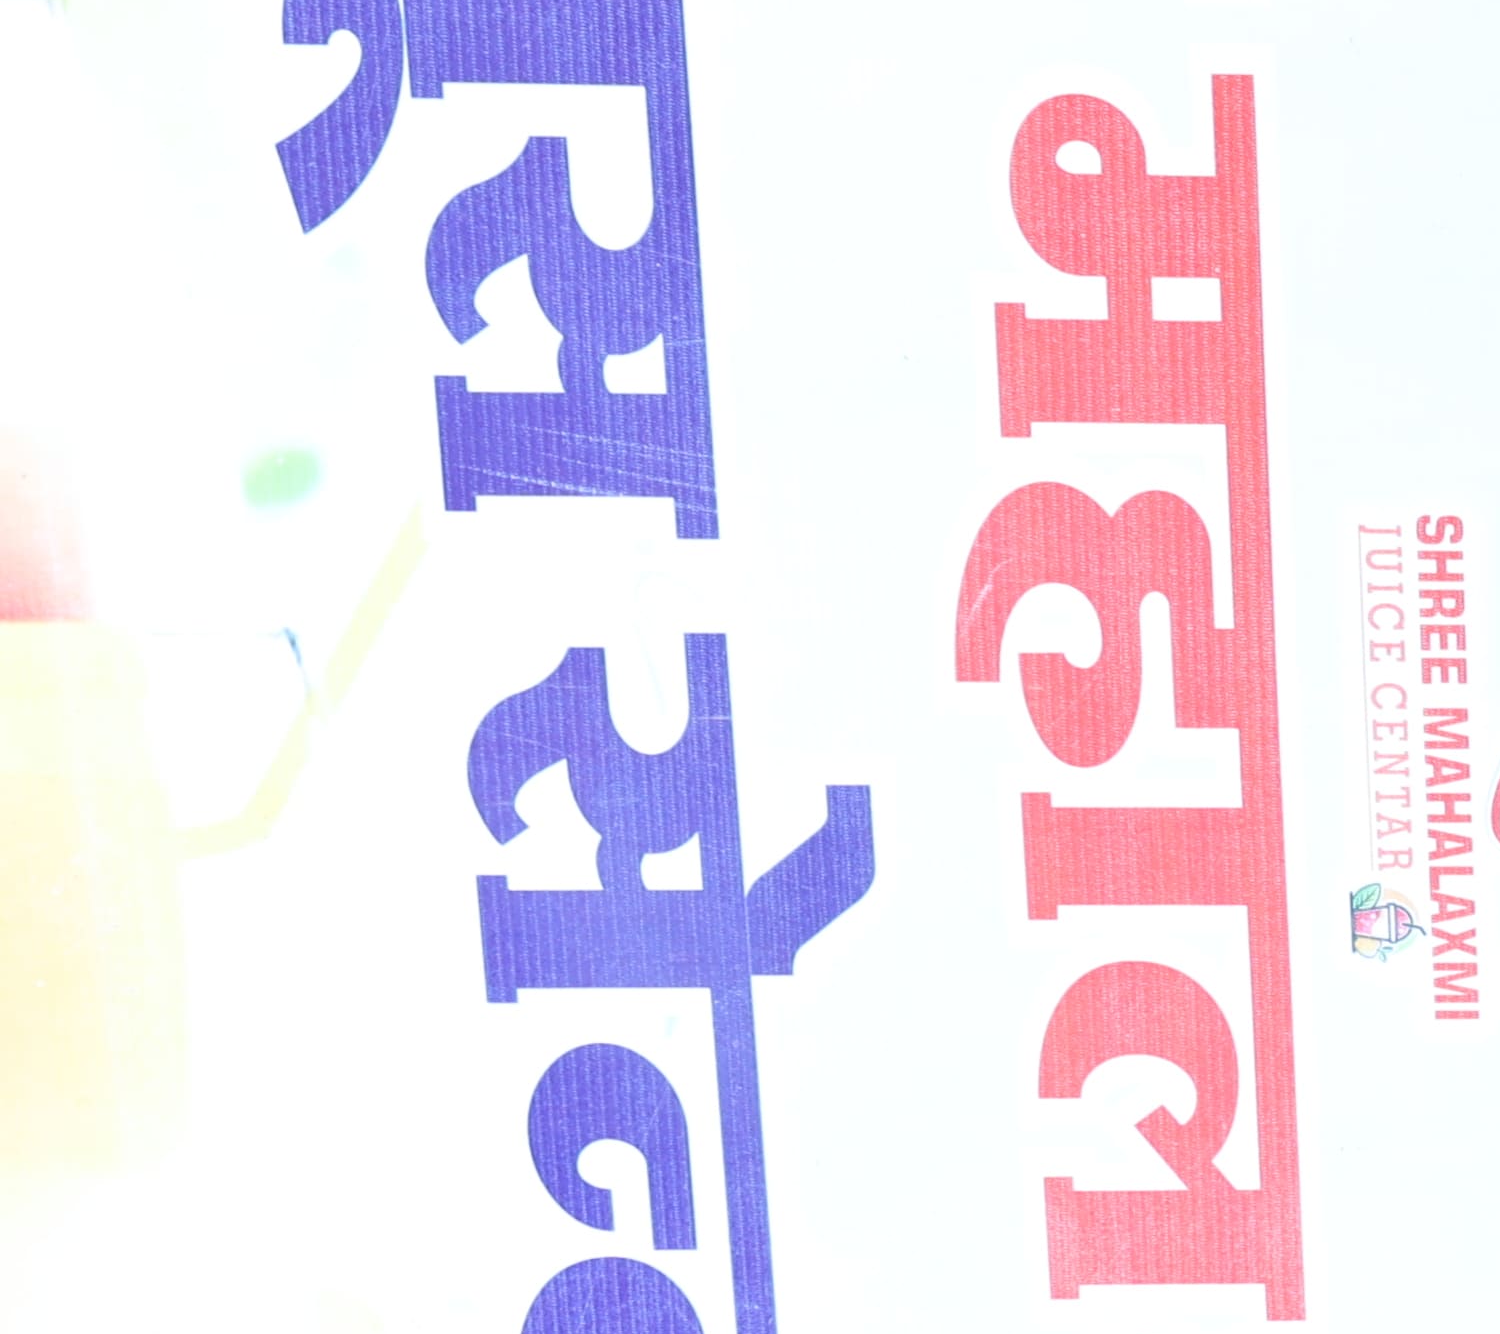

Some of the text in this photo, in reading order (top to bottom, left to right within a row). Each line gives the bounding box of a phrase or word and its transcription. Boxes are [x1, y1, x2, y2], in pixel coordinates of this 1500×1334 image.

[1357, 524, 1414, 873] JUICE CENTAR
[1416, 514, 1480, 1021] SHREE MAHALAXMI
